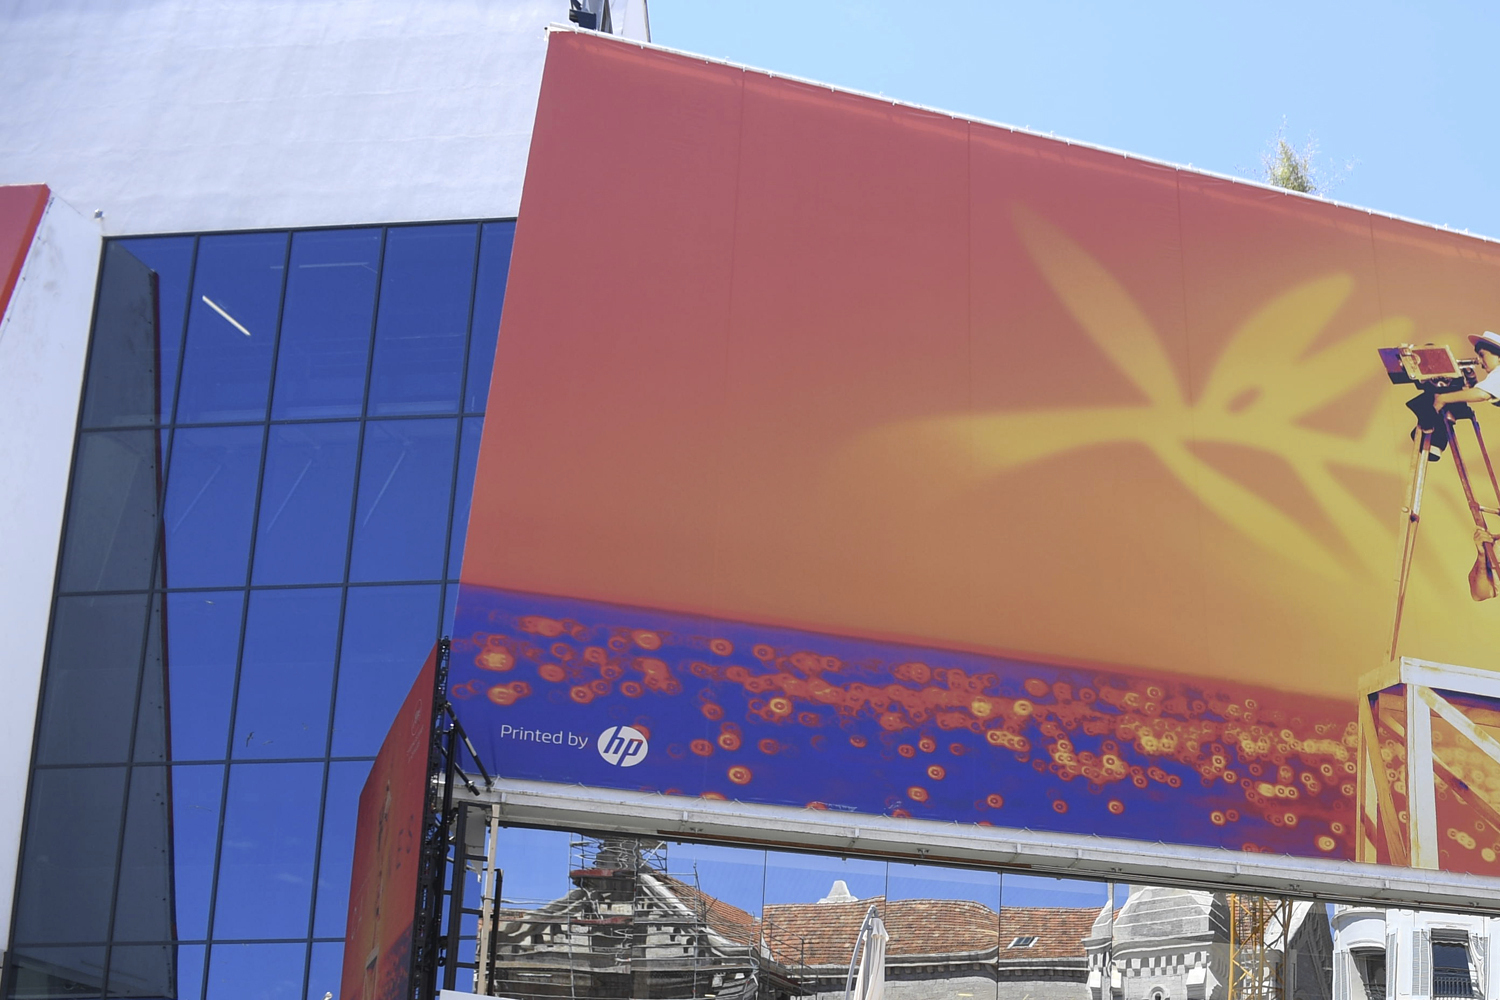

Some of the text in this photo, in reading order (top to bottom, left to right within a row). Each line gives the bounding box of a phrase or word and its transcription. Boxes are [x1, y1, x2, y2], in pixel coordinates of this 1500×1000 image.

[501, 724, 645, 767] Printed by hp
